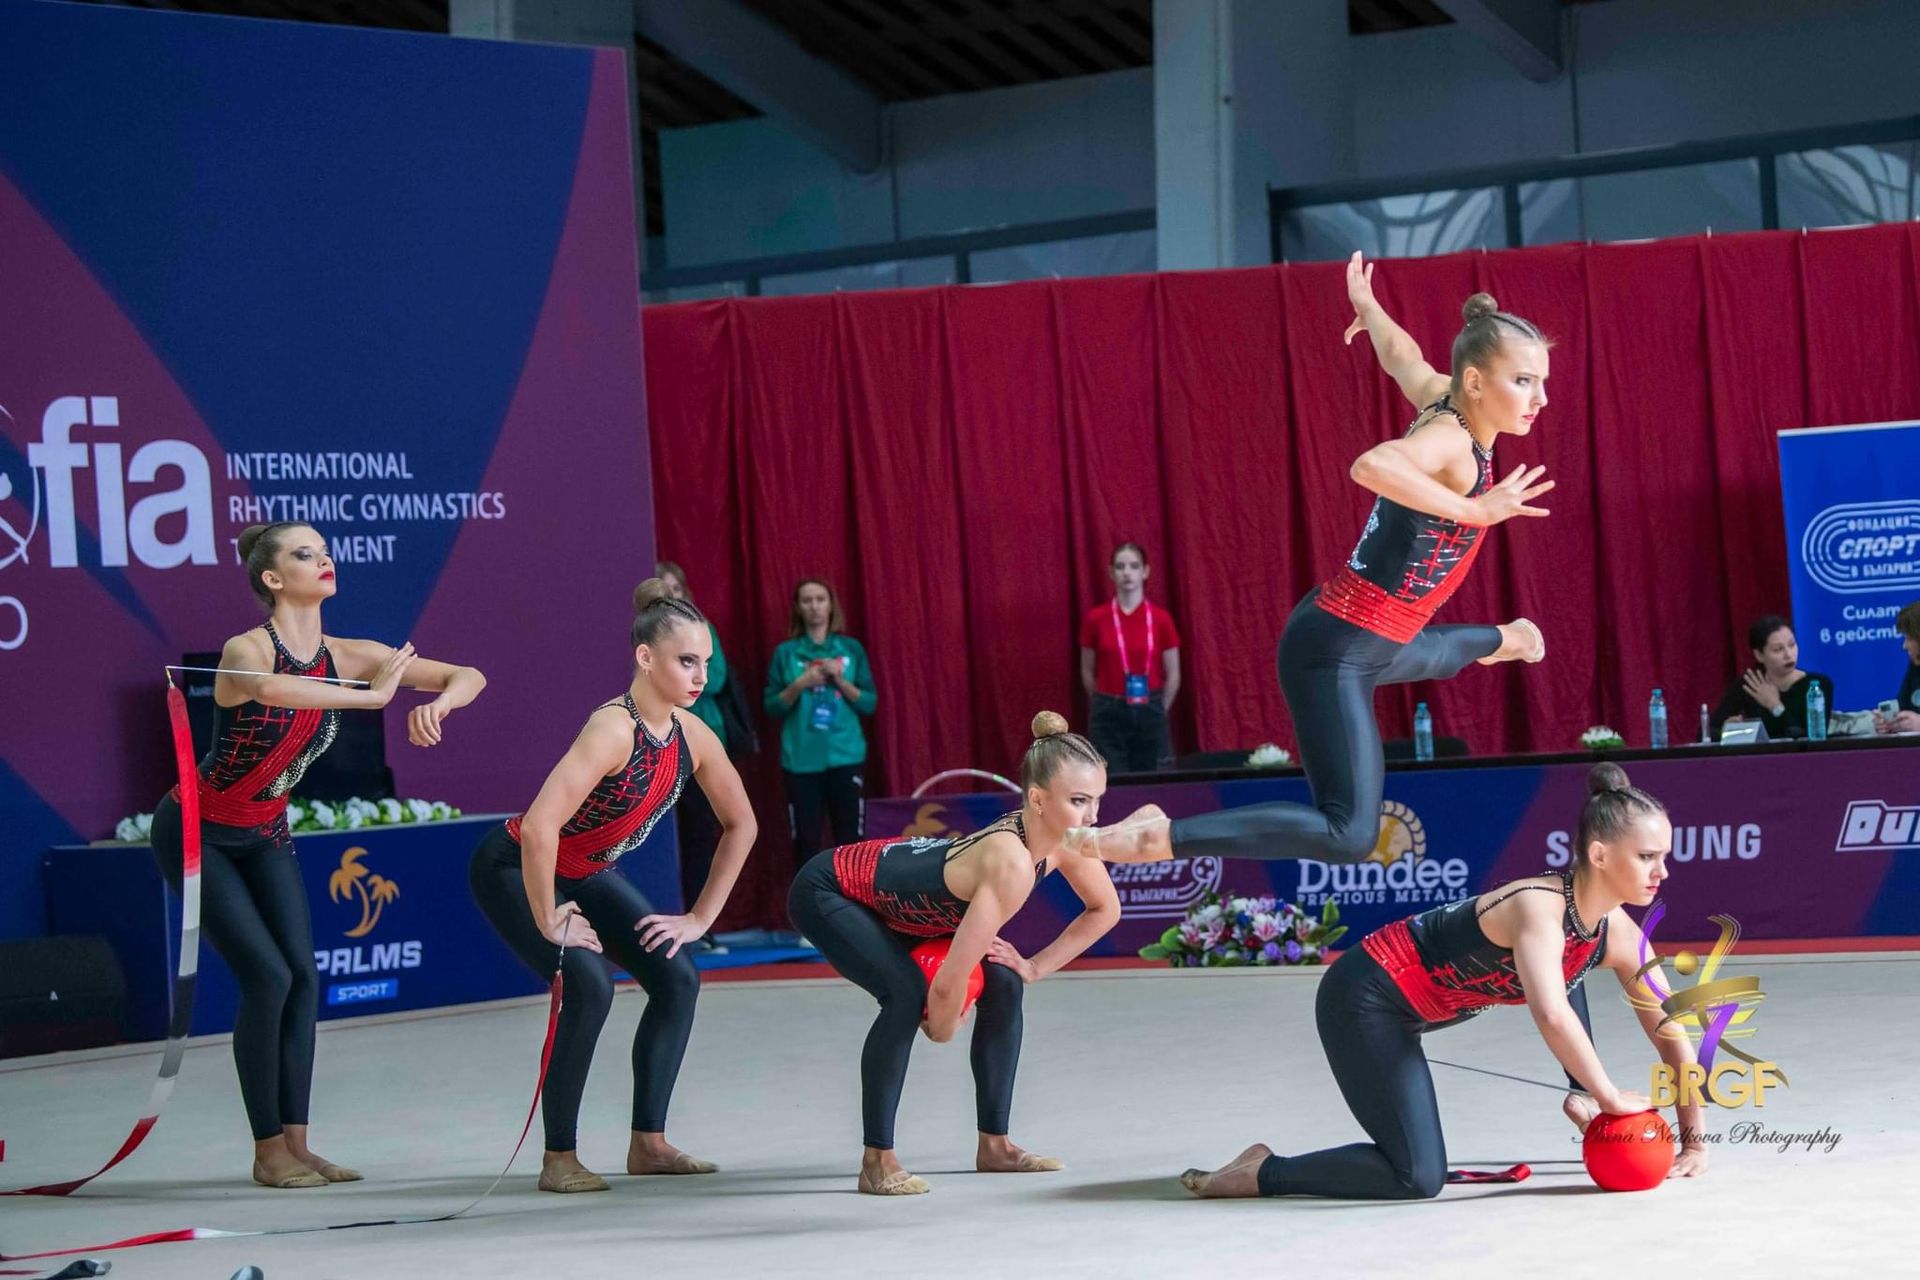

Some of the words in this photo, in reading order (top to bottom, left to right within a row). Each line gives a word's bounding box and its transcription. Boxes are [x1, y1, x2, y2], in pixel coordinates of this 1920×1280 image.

[226, 452, 413, 480] INTERNATIONAL
[229, 495, 354, 522] RHYTHMIC
[360, 492, 506, 521] GYMNASTICS
[230, 535, 397, 565] TMENT
[1838, 534, 1920, 560] СПОРТ
[1843, 605, 1902, 620] Силат
[1841, 805, 1920, 846] Du
[1546, 823, 1762, 867] SUNG
[1296, 851, 1469, 894] Dundee
[1297, 890, 1386, 906] PRECIOUS
[1395, 887, 1468, 903] METALS
[338, 982, 388, 1002] SPORT
